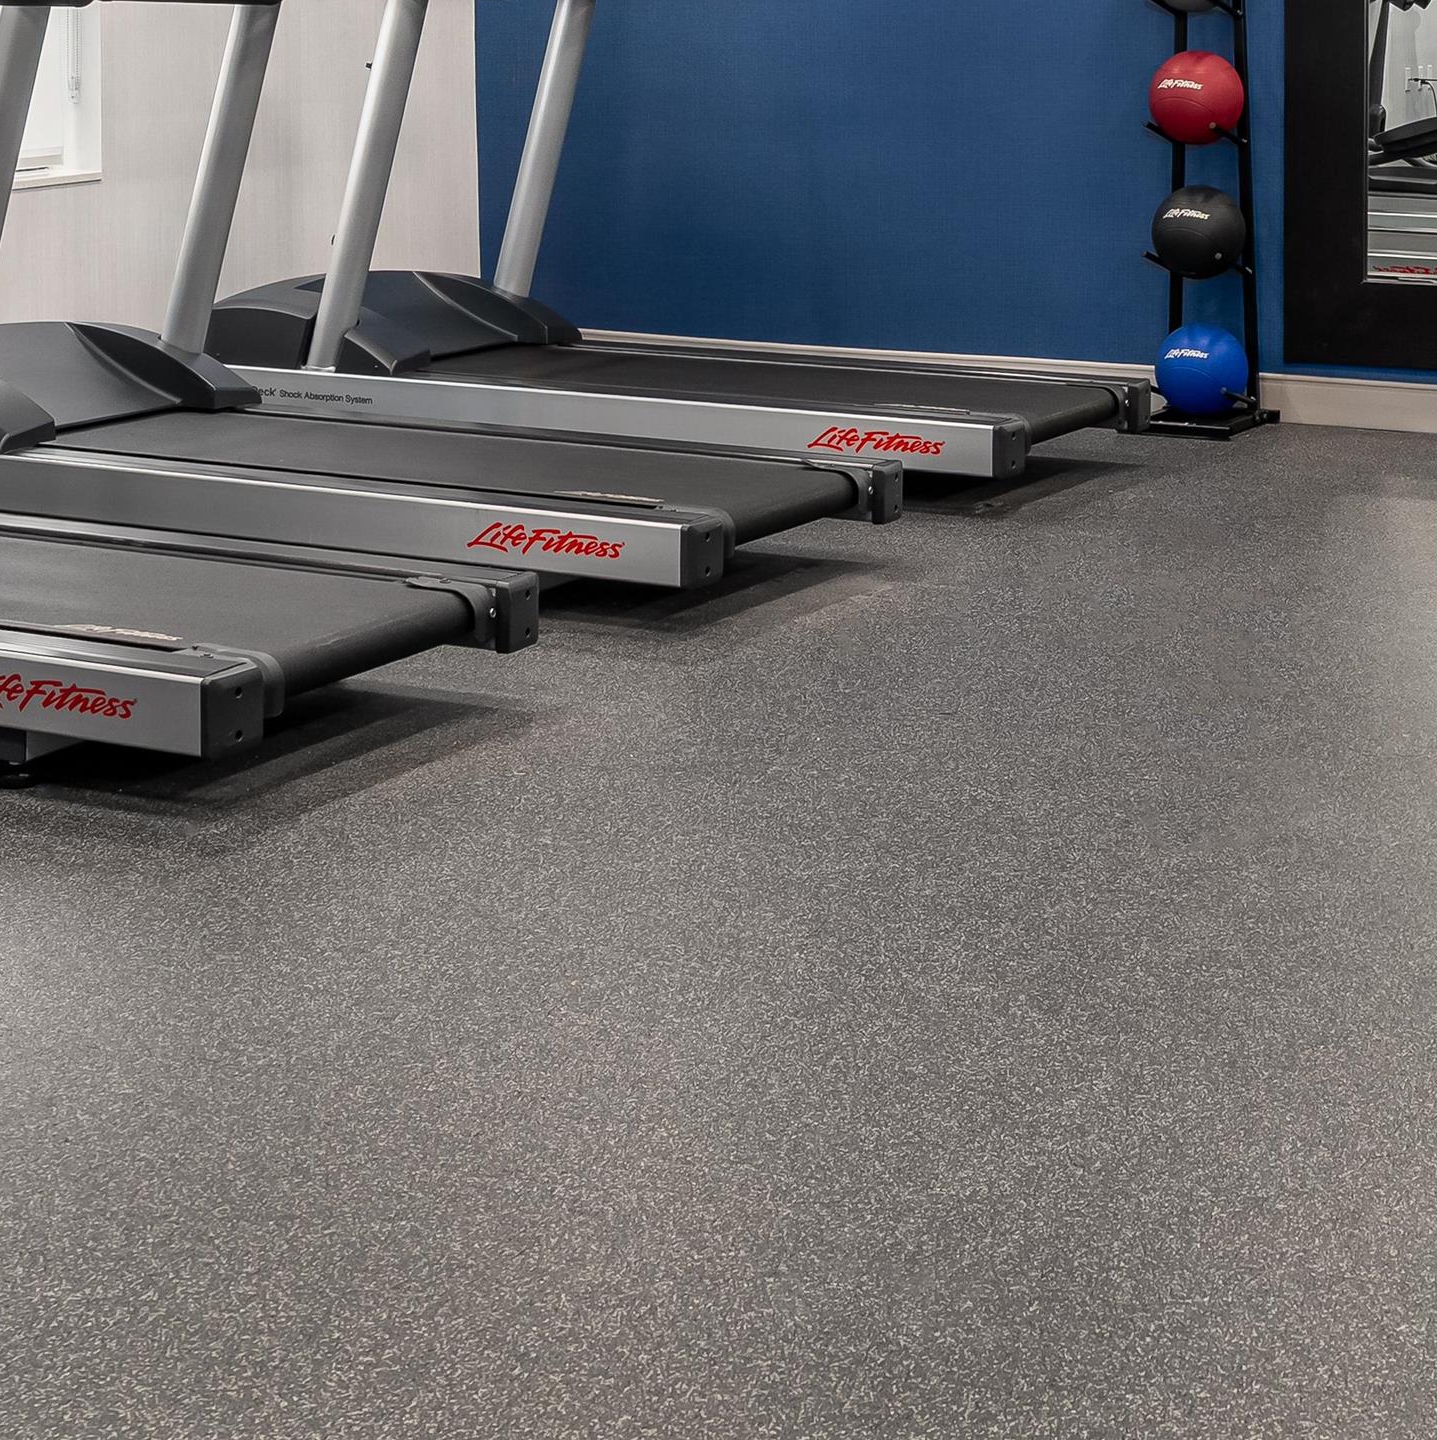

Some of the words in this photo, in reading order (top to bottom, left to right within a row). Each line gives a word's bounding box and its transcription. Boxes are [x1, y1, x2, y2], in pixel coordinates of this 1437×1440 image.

[280, 389, 302, 399] Shock
[304, 392, 343, 403] Absorption
[345, 394, 373, 405] System
